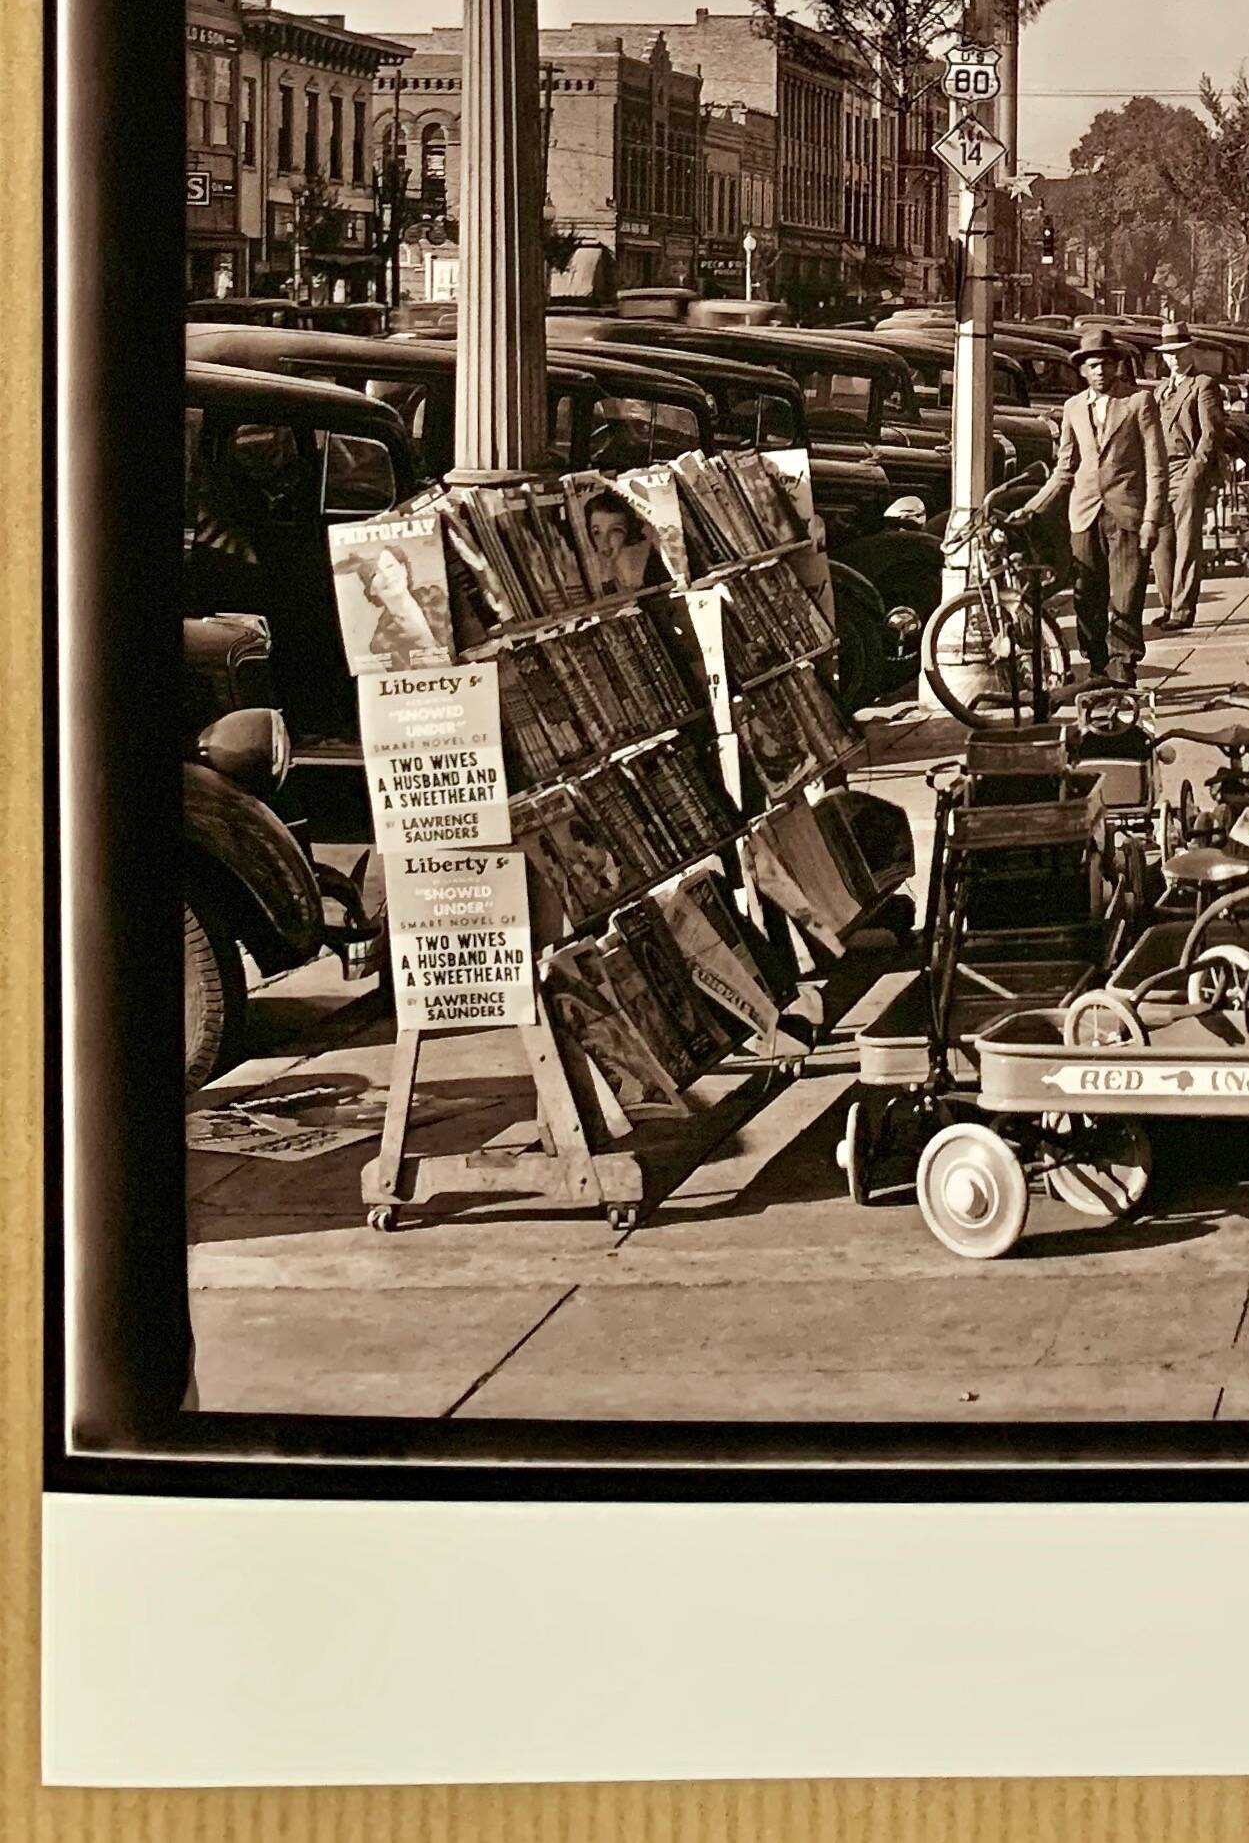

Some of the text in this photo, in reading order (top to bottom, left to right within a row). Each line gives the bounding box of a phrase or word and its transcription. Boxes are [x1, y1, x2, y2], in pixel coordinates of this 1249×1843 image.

[955, 69, 990, 95] 80
[960, 142, 983, 166] 14
[379, 675, 463, 697] Liberty
[422, 736, 467, 749] NOVEL
[471, 733, 489, 745] OF
[389, 751, 479, 774] TWO WIVES
[377, 767, 498, 793] A HUSBAND AND
[383, 784, 496, 810] A SWEETHEART
[402, 812, 480, 831] LAWRENCE
[404, 825, 480, 844] SAUNDERS
[404, 857, 489, 875] Liberty
[450, 915, 495, 927] NOVEL
[501, 914, 518, 925] OF
[415, 931, 508, 952] TWO WIVES
[401, 949, 525, 971] A HUSBAND AND
[406, 966, 521, 988] A SWEETHEART
[424, 991, 506, 1009] LAWRENCE
[427, 1004, 506, 1022] SAUNDERS
[1080, 1069, 1145, 1091] RED
